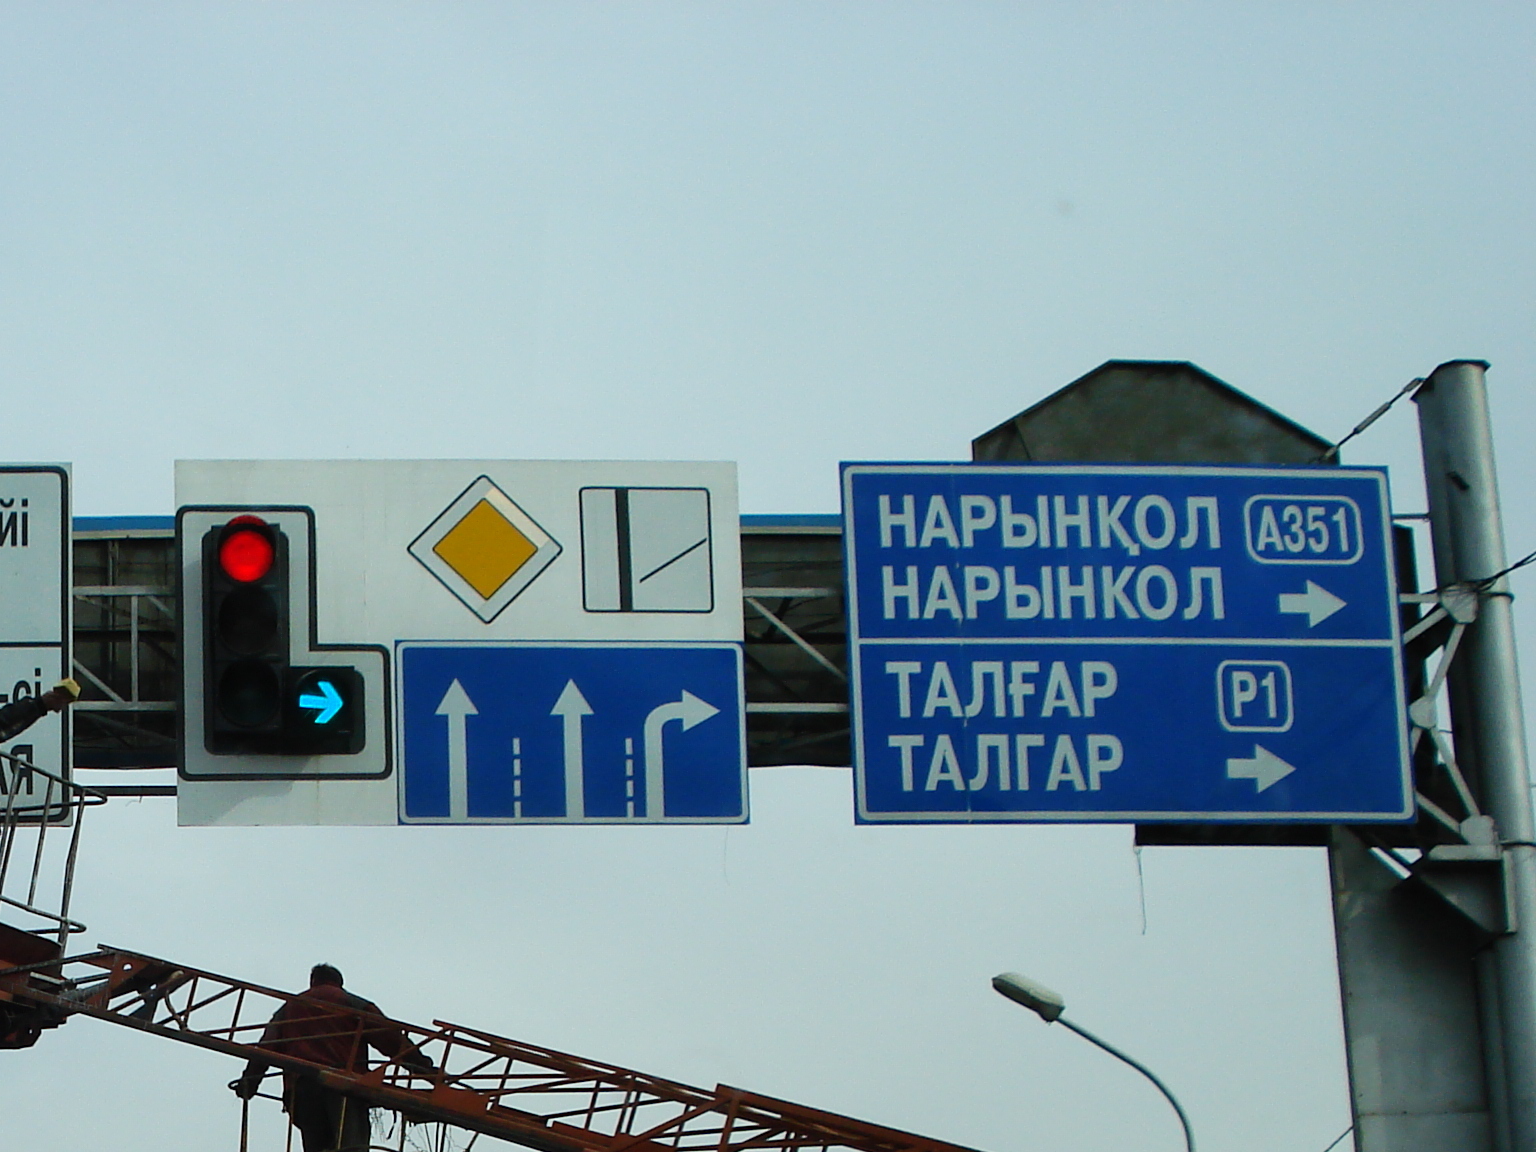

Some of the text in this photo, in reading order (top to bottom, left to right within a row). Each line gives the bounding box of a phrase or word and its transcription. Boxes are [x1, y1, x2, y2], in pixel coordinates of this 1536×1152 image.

[878, 494, 1222, 556] НАРЫНҚОЛ
[881, 564, 1226, 621] НАРЫНКОЛ
[884, 660, 1119, 719] ТАЛҒАР
[887, 733, 1124, 792] ТАЛГАР
